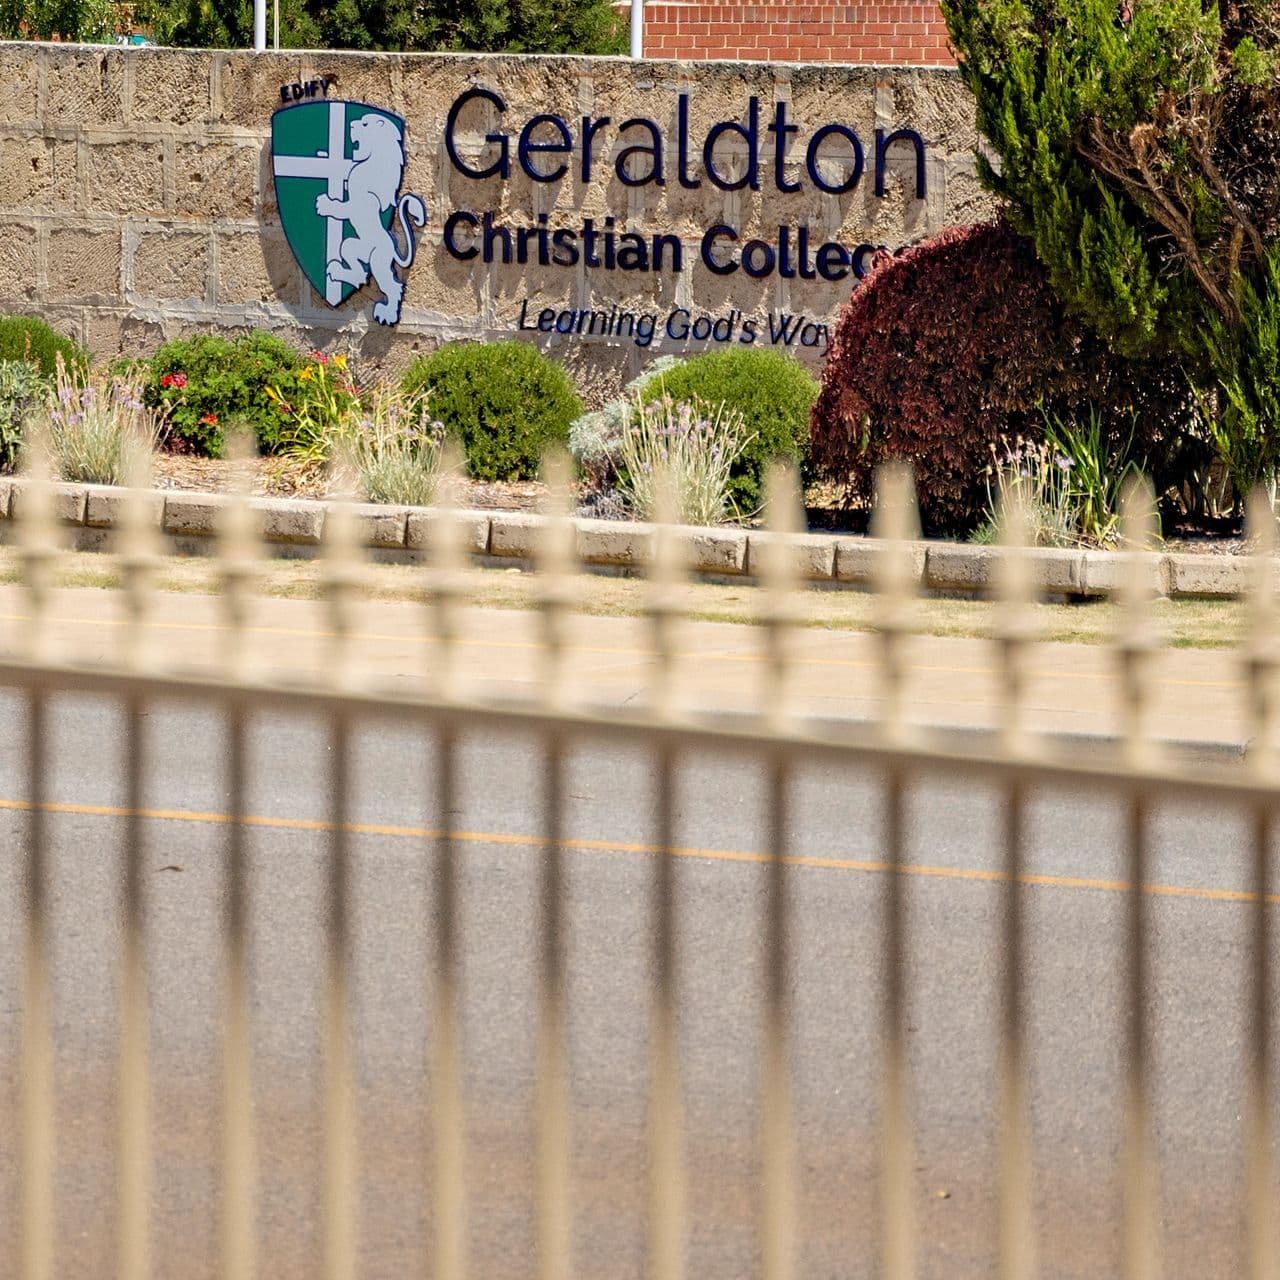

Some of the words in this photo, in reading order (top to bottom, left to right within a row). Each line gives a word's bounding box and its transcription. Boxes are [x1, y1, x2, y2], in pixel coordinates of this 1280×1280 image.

[280, 78, 331, 102] EDIFY
[445, 88, 926, 200] Geraldton
[444, 210, 683, 273] Christian
[701, 224, 910, 292] Colle
[519, 299, 657, 347] Learning
[666, 308, 757, 344] God's
